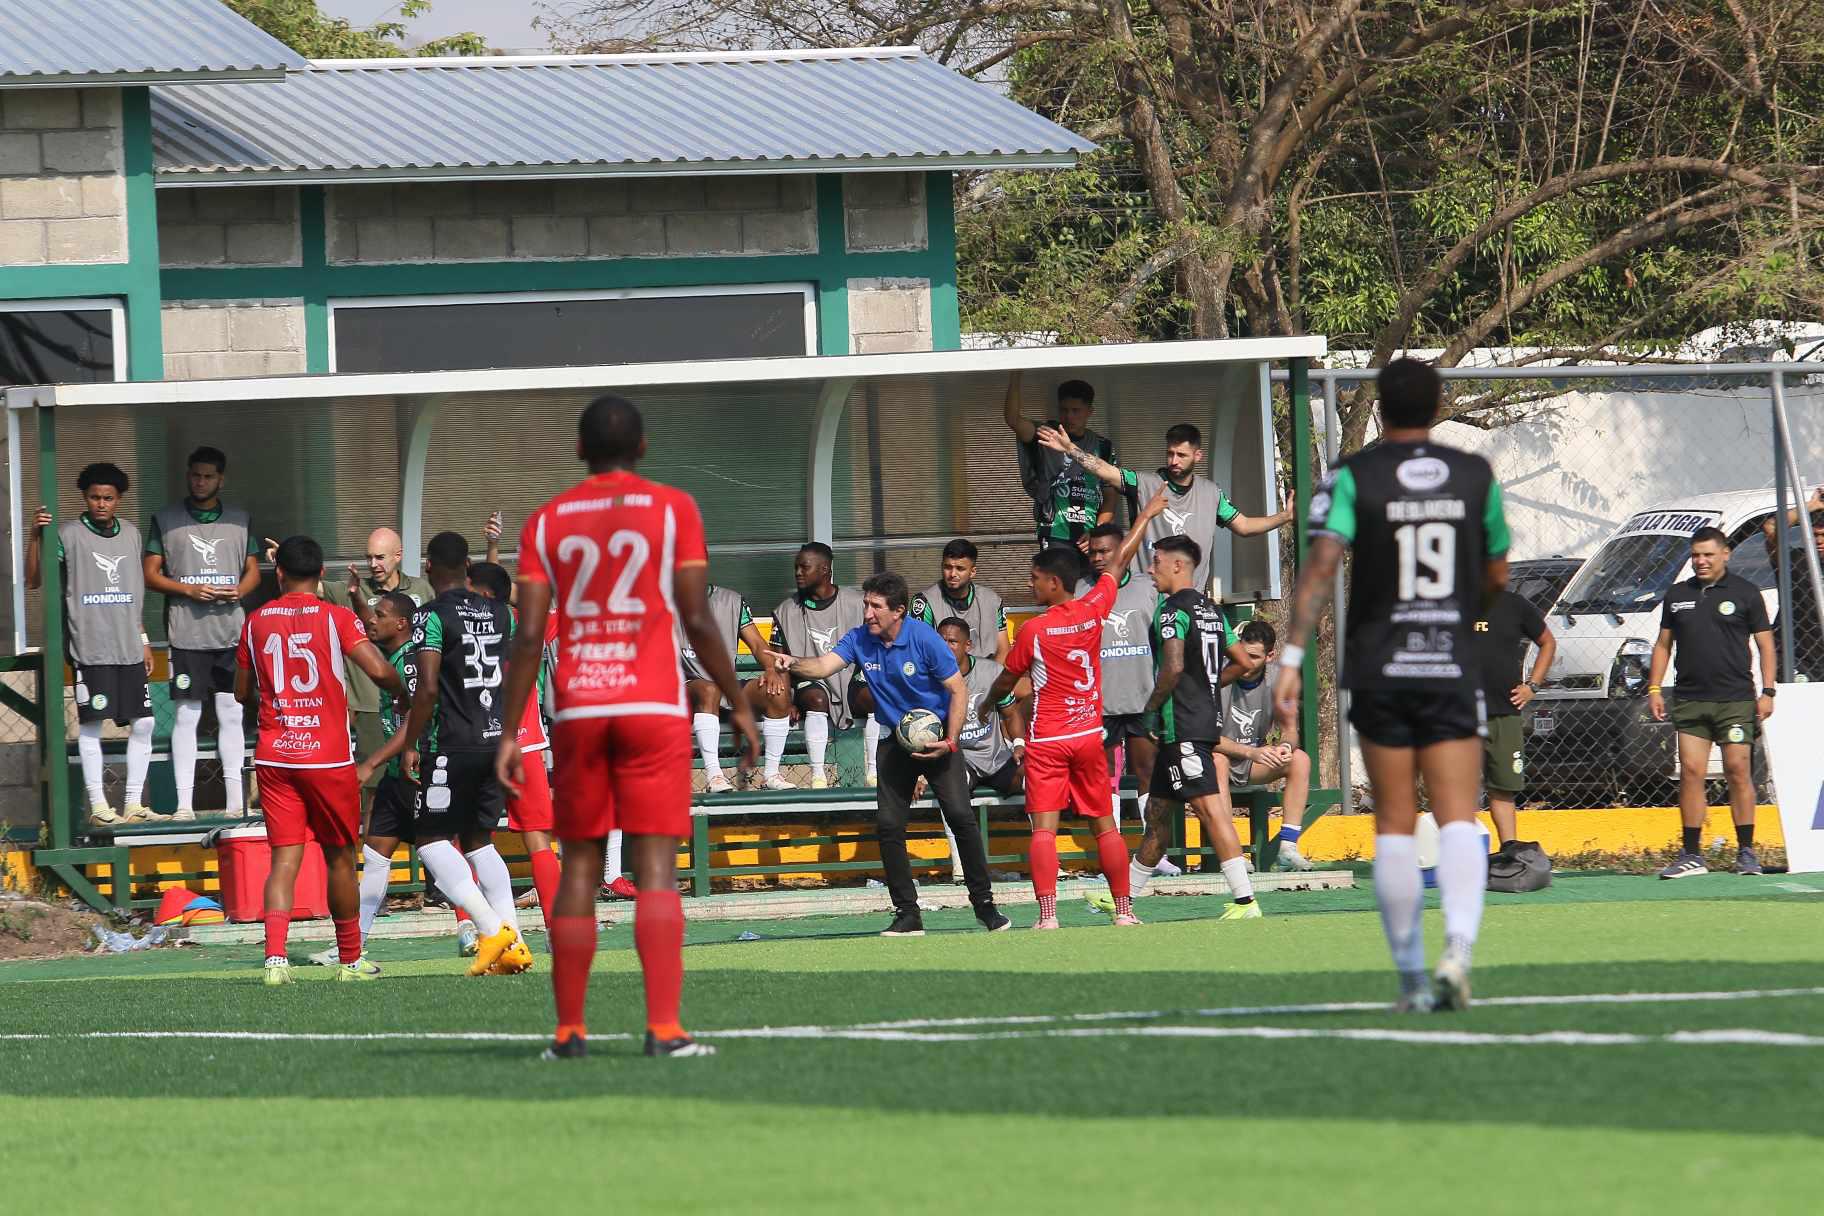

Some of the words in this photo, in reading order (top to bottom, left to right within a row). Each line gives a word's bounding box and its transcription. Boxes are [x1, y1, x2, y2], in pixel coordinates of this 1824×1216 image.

[558, 529, 650, 617] 22
[1394, 522, 1456, 600] 19
[263, 632, 320, 694] 15
[462, 633, 502, 688] 35
[1067, 649, 1095, 691] 3
[1100, 646, 1148, 658] ONDUBET
[278, 698, 291, 708] EL
[293, 697, 323, 708] TITAN
[1169, 765, 1180, 782] 10
